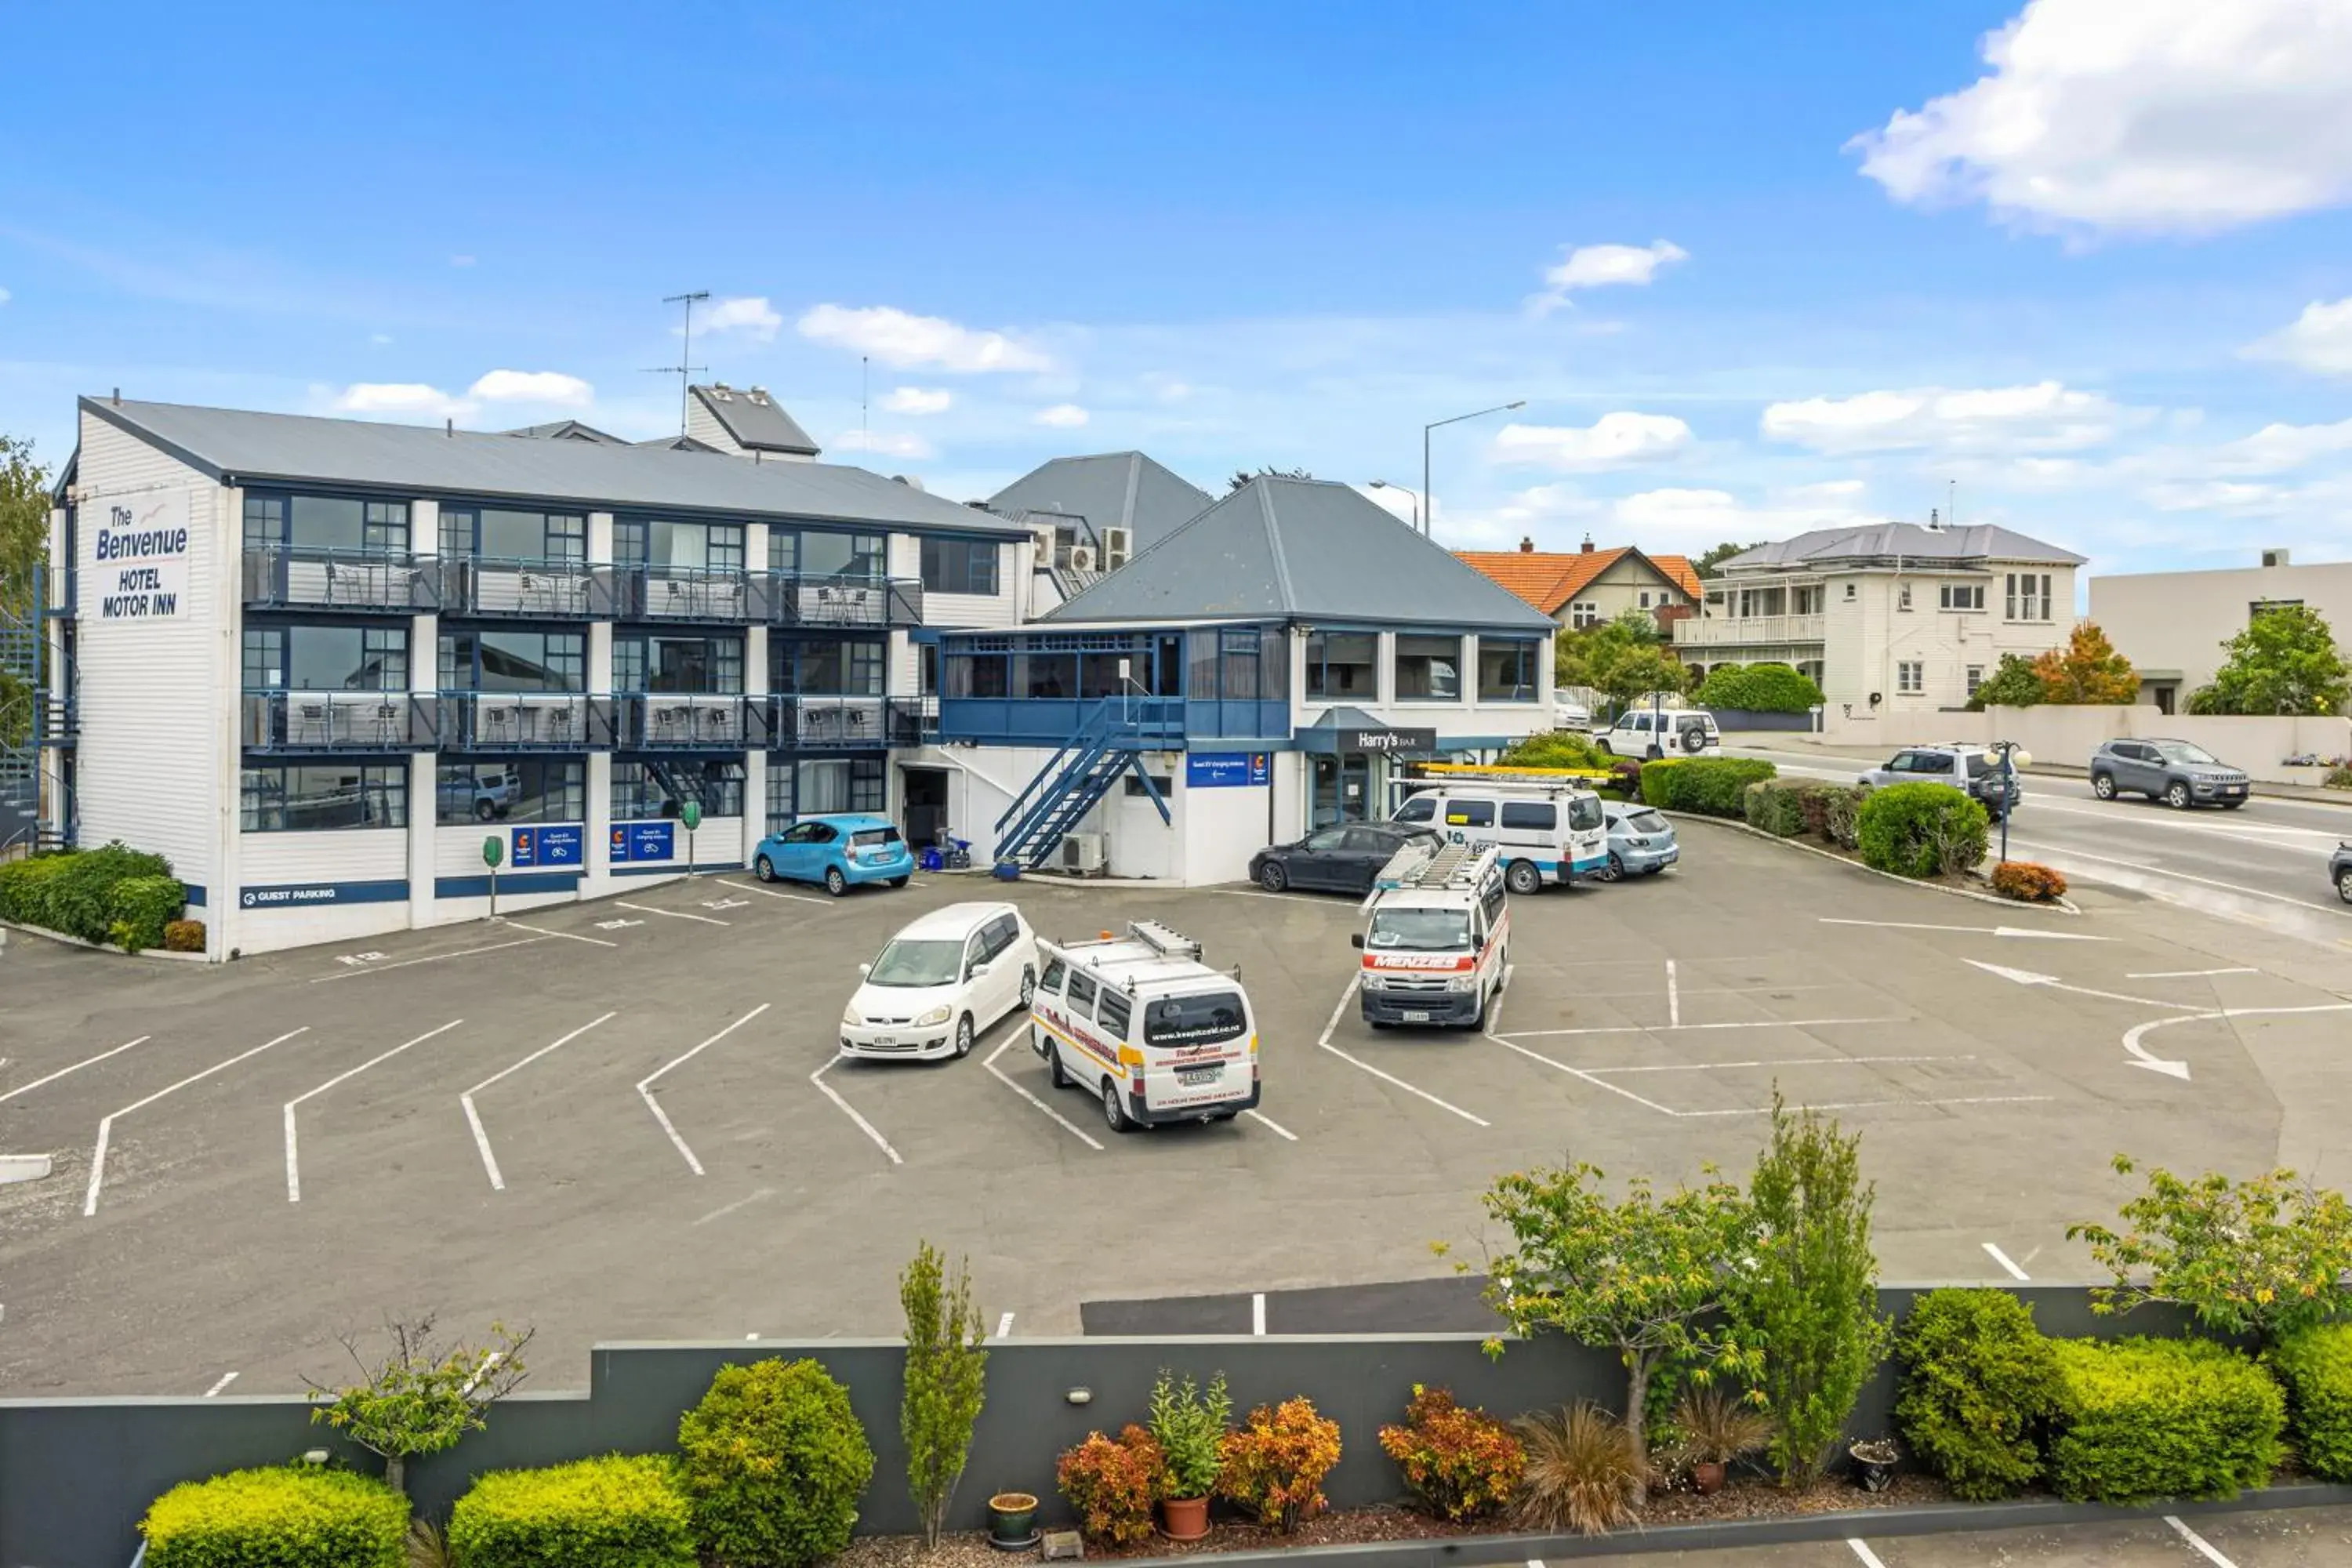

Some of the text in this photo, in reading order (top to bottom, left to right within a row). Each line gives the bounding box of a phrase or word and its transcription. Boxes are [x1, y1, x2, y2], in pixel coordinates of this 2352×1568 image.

[111, 506, 132, 527] The
[96, 527, 187, 561] Benvenue
[119, 568, 161, 592] HOTEL
[103, 593, 176, 618] MOTOR INN
[1359, 731, 1398, 750] Harry's
[257, 888, 336, 901] GUEST PARKING
